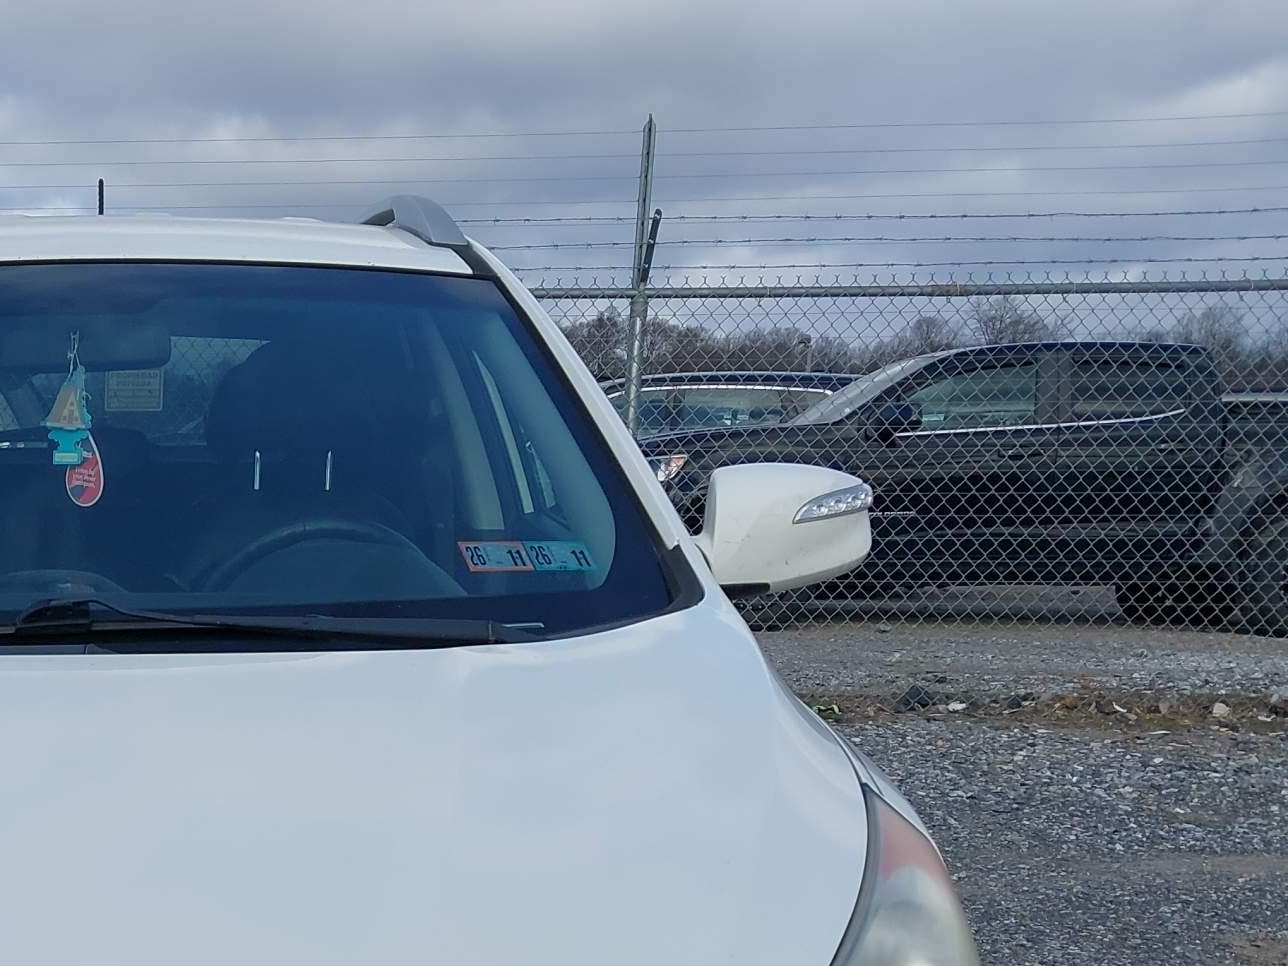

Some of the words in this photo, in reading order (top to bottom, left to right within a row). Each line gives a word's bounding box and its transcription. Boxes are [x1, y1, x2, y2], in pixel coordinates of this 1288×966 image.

[465, 546, 488, 566] 26
[506, 549, 527, 567] 11
[529, 545, 552, 566] 26
[570, 549, 592, 567] 11
